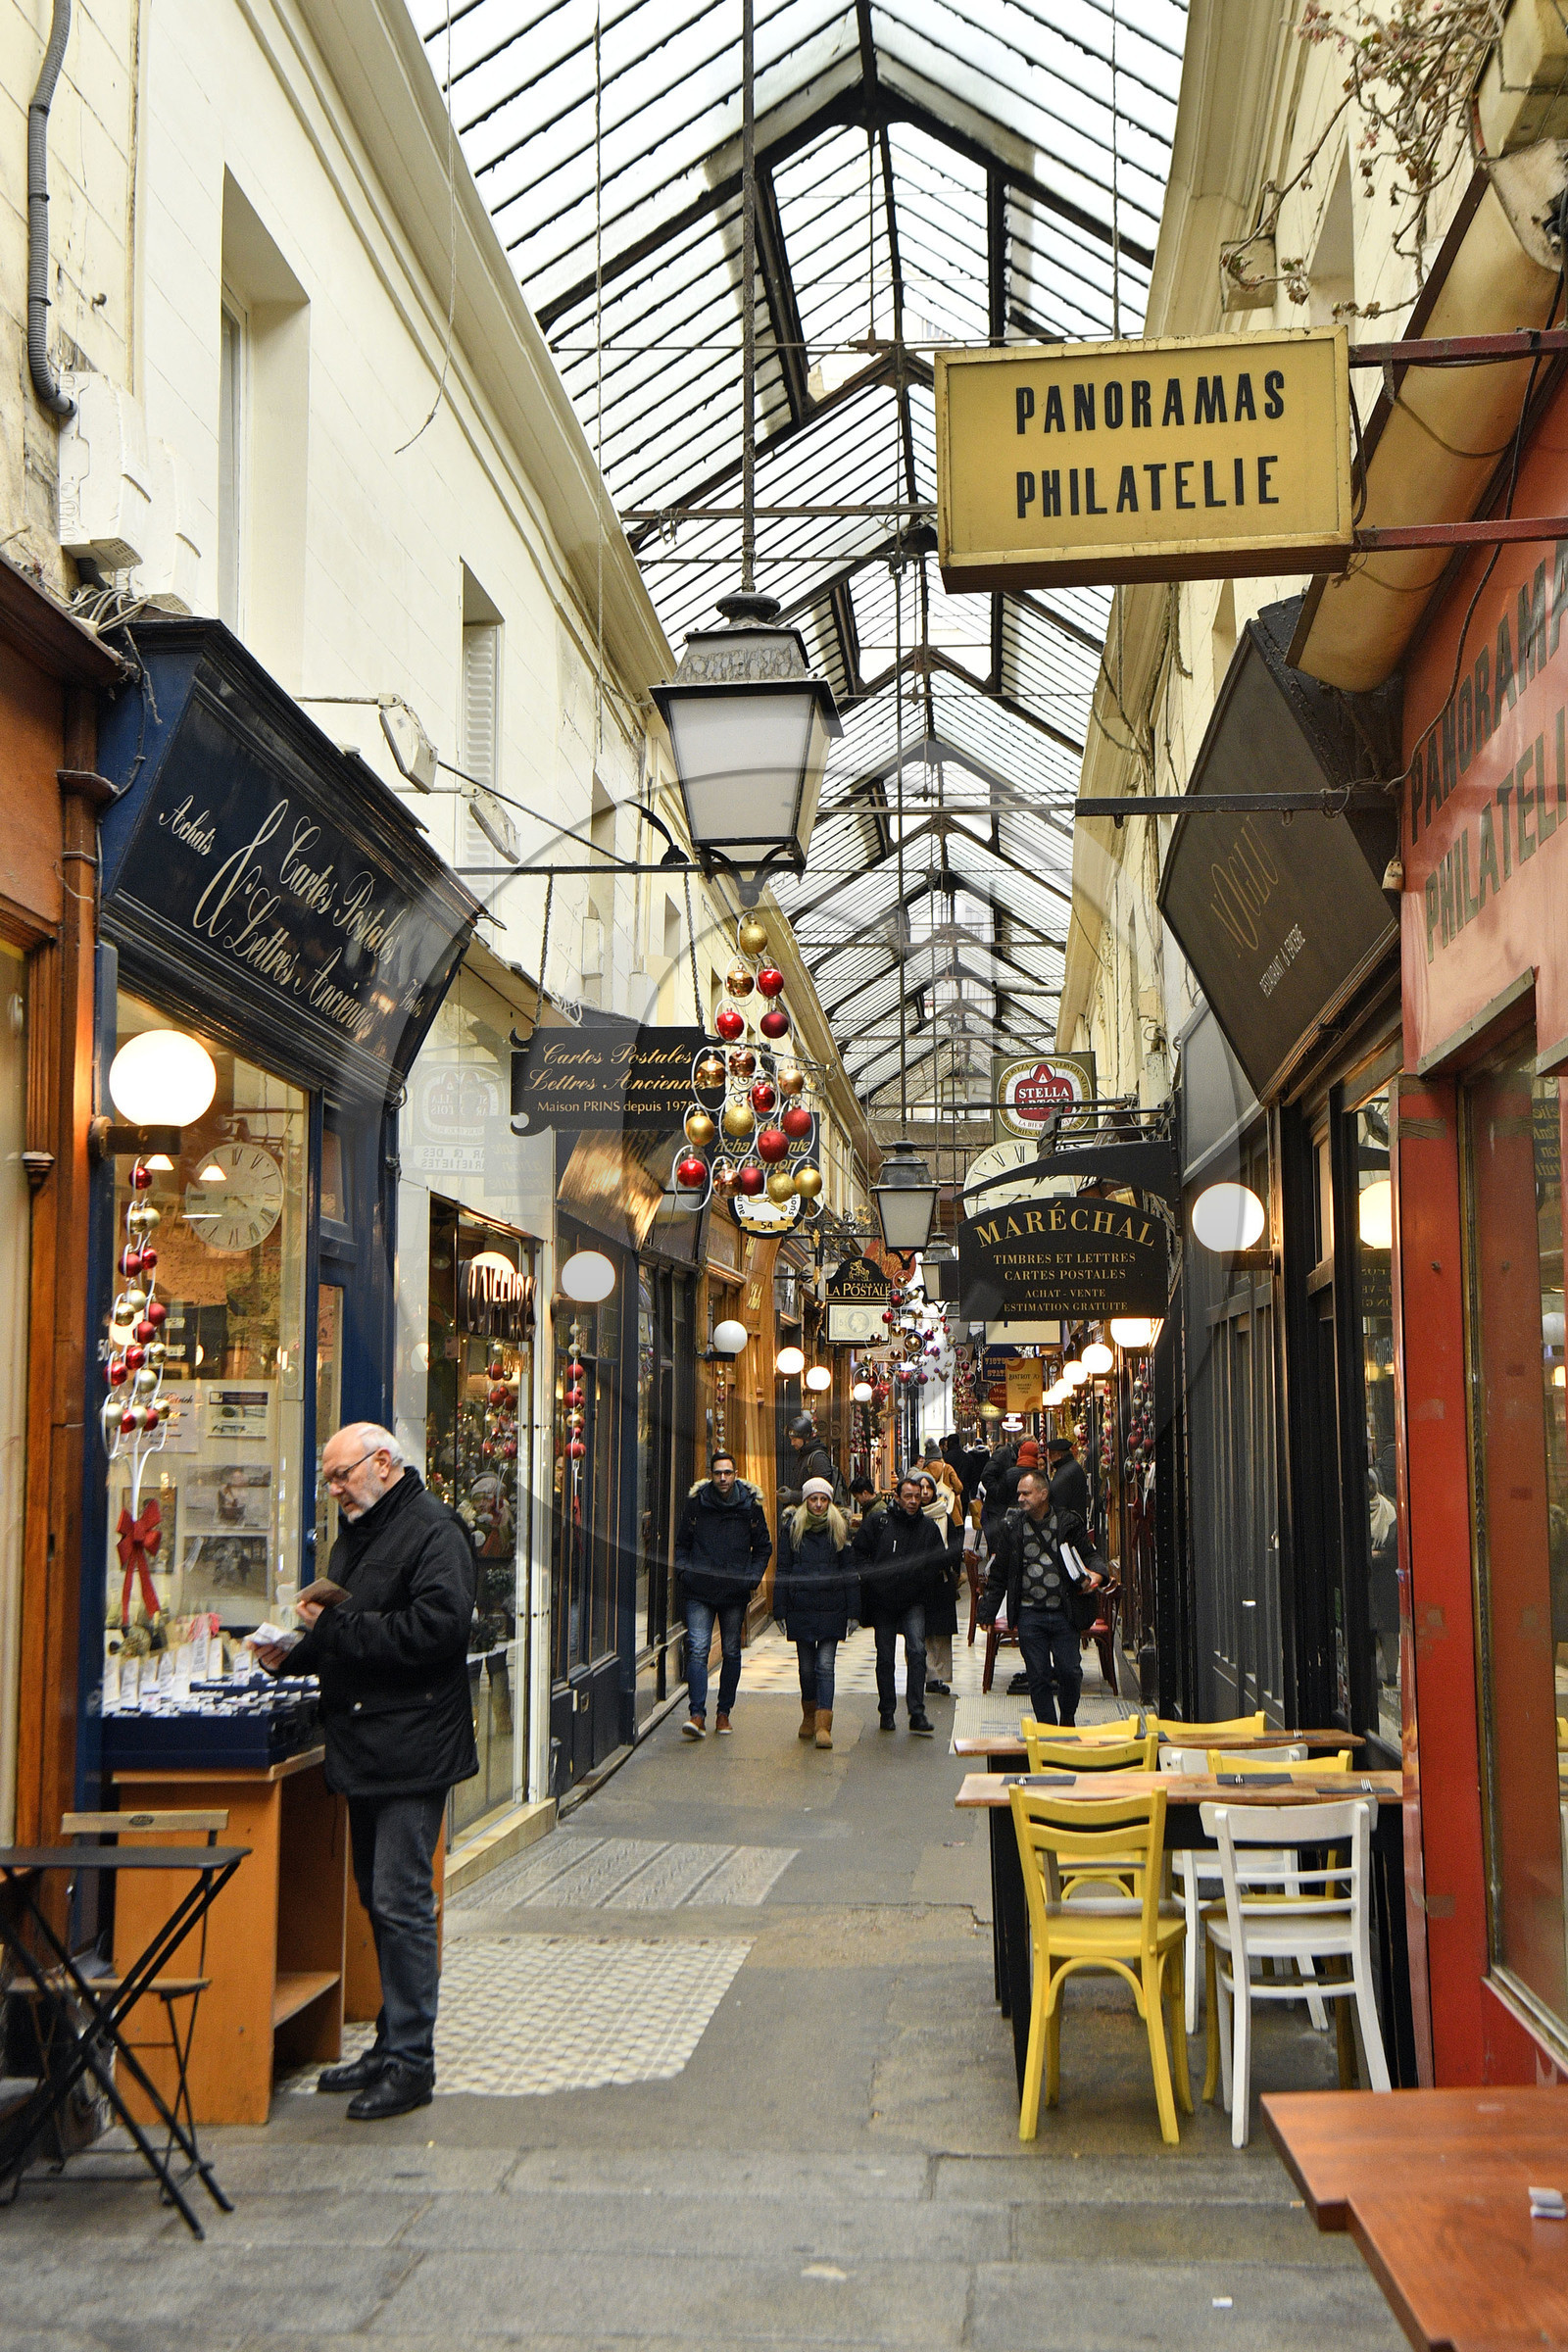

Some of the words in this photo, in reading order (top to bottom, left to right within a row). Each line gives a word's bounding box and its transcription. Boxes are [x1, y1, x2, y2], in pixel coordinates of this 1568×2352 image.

[1015, 369, 1284, 435] PANORAMAS
[1015, 455, 1279, 518] PHILATELIE
[159, 795, 217, 856] Achats
[279, 815, 338, 914] Cartes
[333, 871, 407, 965] Postales
[223, 887, 301, 986] Lettres
[543, 1042, 603, 1064] Cartes
[611, 1042, 693, 1064] Postales
[524, 1068, 597, 1092] Lettres
[603, 1068, 706, 1091] Anciennes
[1018, 1087, 1070, 1099] STELLA
[537, 1101, 580, 1112] Maison
[583, 1101, 621, 1112] PRINS
[623, 1100, 662, 1114] depuis
[713, 1138, 751, 1152] Acha
[973, 1200, 1155, 1249] MARÉCHAL
[993, 1253, 1052, 1264] TIMBRES
[1056, 1253, 1073, 1263] ET
[1077, 1252, 1136, 1263] LETTRES
[1004, 1270, 1055, 1281] CARTES
[1059, 1269, 1126, 1280] POSTALES
[825, 1283, 841, 1297] LA
[843, 1283, 891, 1297] POSTALE
[1025, 1289, 1061, 1298] ACHAT
[1070, 1288, 1106, 1298] VENTE
[1004, 1302, 1069, 1312] ESTIMATION
[1072, 1301, 1128, 1311] GRATUITE
[98, 1339, 110, 1361] 50
